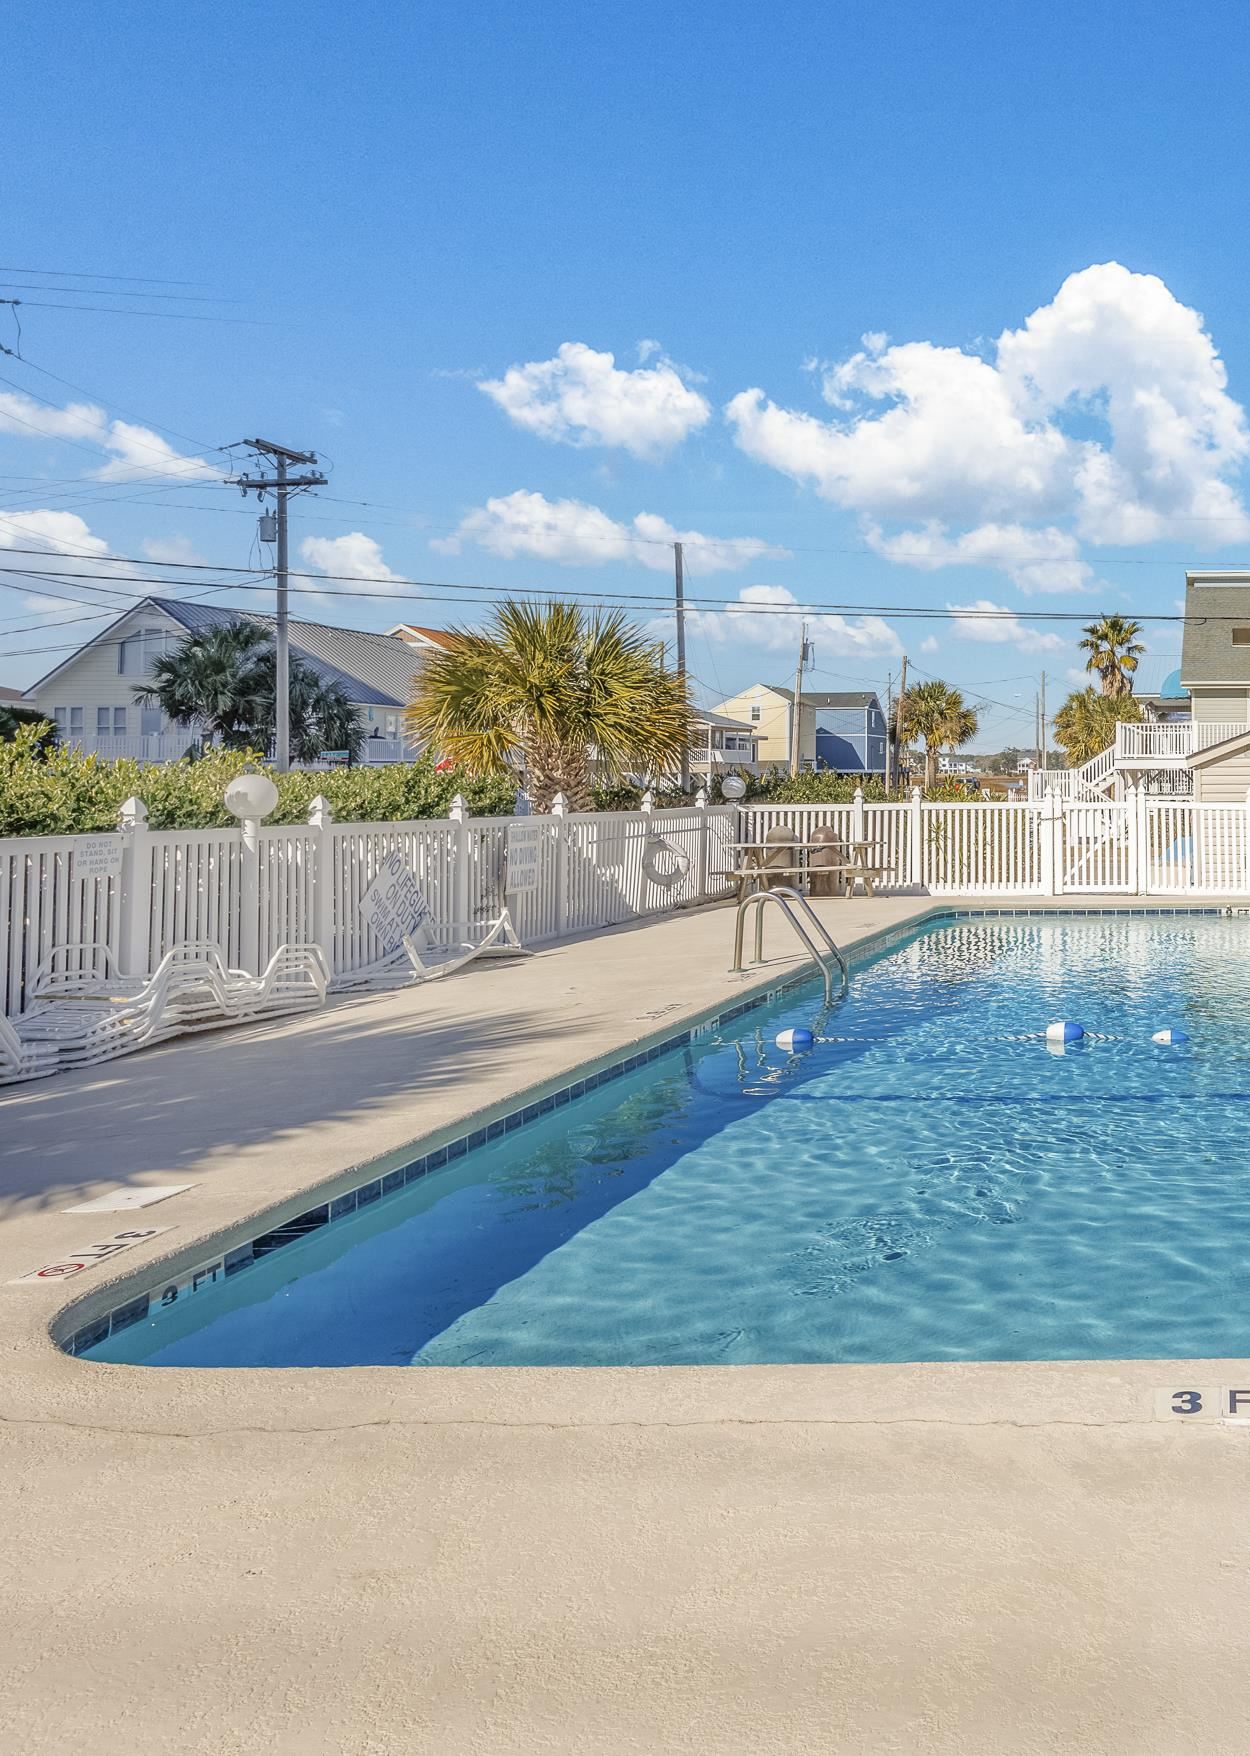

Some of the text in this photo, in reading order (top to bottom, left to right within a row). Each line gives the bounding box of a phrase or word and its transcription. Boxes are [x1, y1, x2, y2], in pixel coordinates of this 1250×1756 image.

[89, 858, 109, 866] HANG
[384, 850, 400, 876] NO
[510, 869, 536, 888] ALLOWED
[386, 883, 401, 909] ON
[370, 889, 400, 935] SWIM AT
[370, 911, 389, 941] OWN
[69, 1230, 157, 1259] 3 FT
[161, 1262, 222, 1307] 3 FT
[1171, 1390, 1203, 1414] 3
